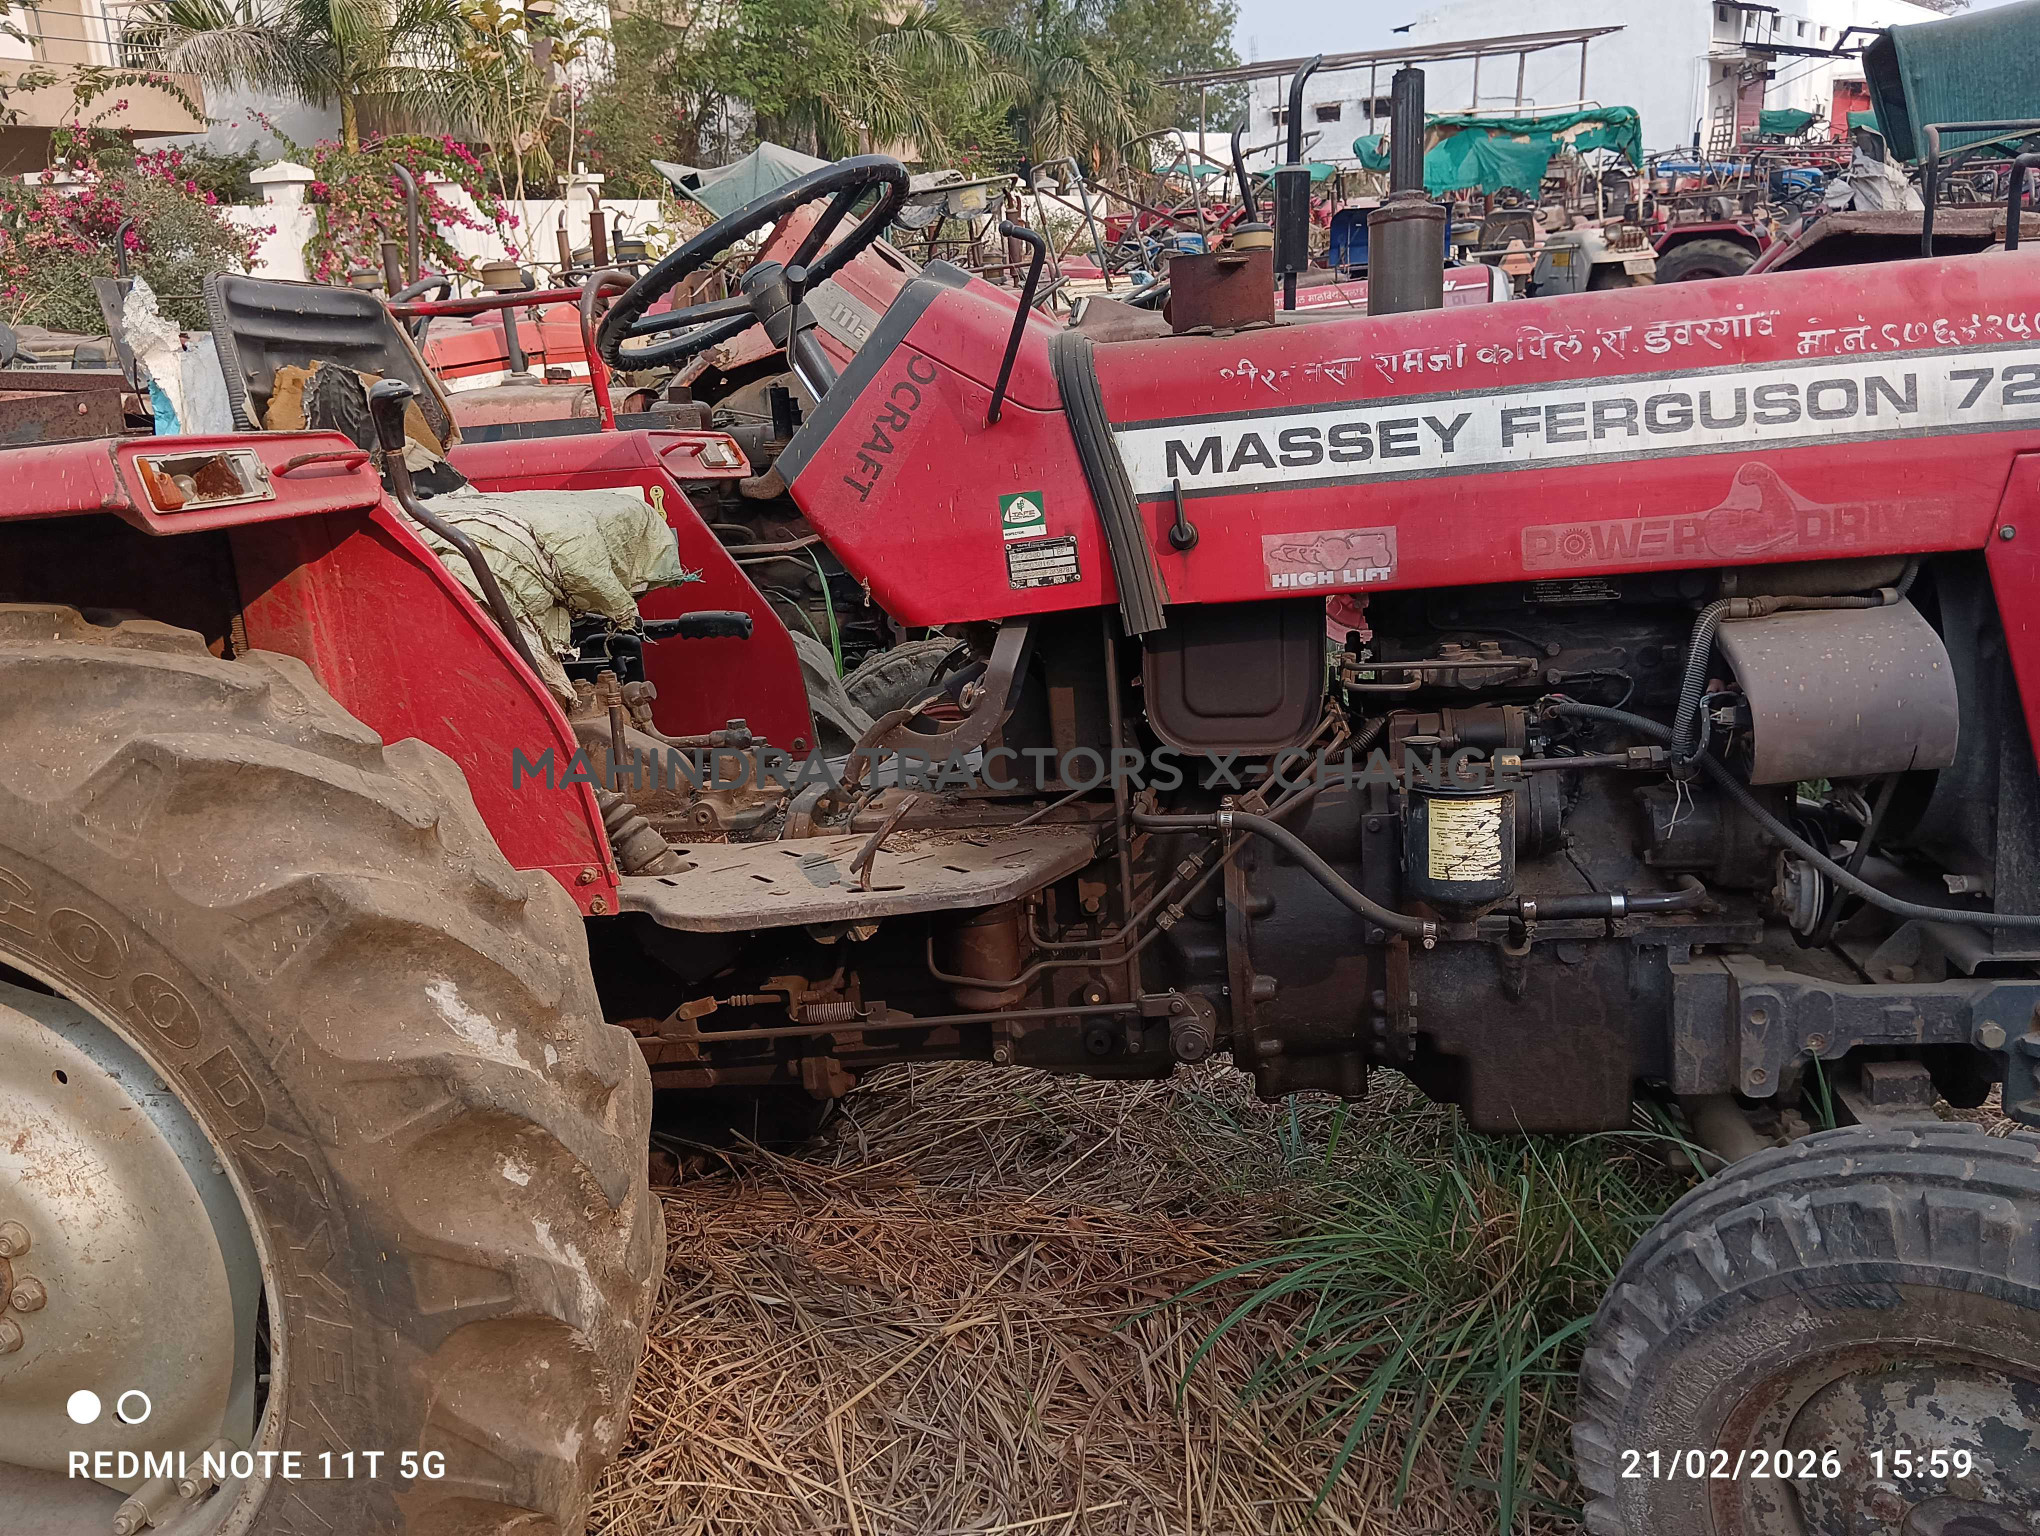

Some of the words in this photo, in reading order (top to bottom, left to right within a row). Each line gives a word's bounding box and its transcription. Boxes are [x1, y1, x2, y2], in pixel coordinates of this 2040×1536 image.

[1165, 412, 1473, 478] MASSEY
[1500, 373, 1918, 448] FERGUSON
[1272, 570, 1334, 588] HIGH
[1343, 566, 1391, 583] LIFT
